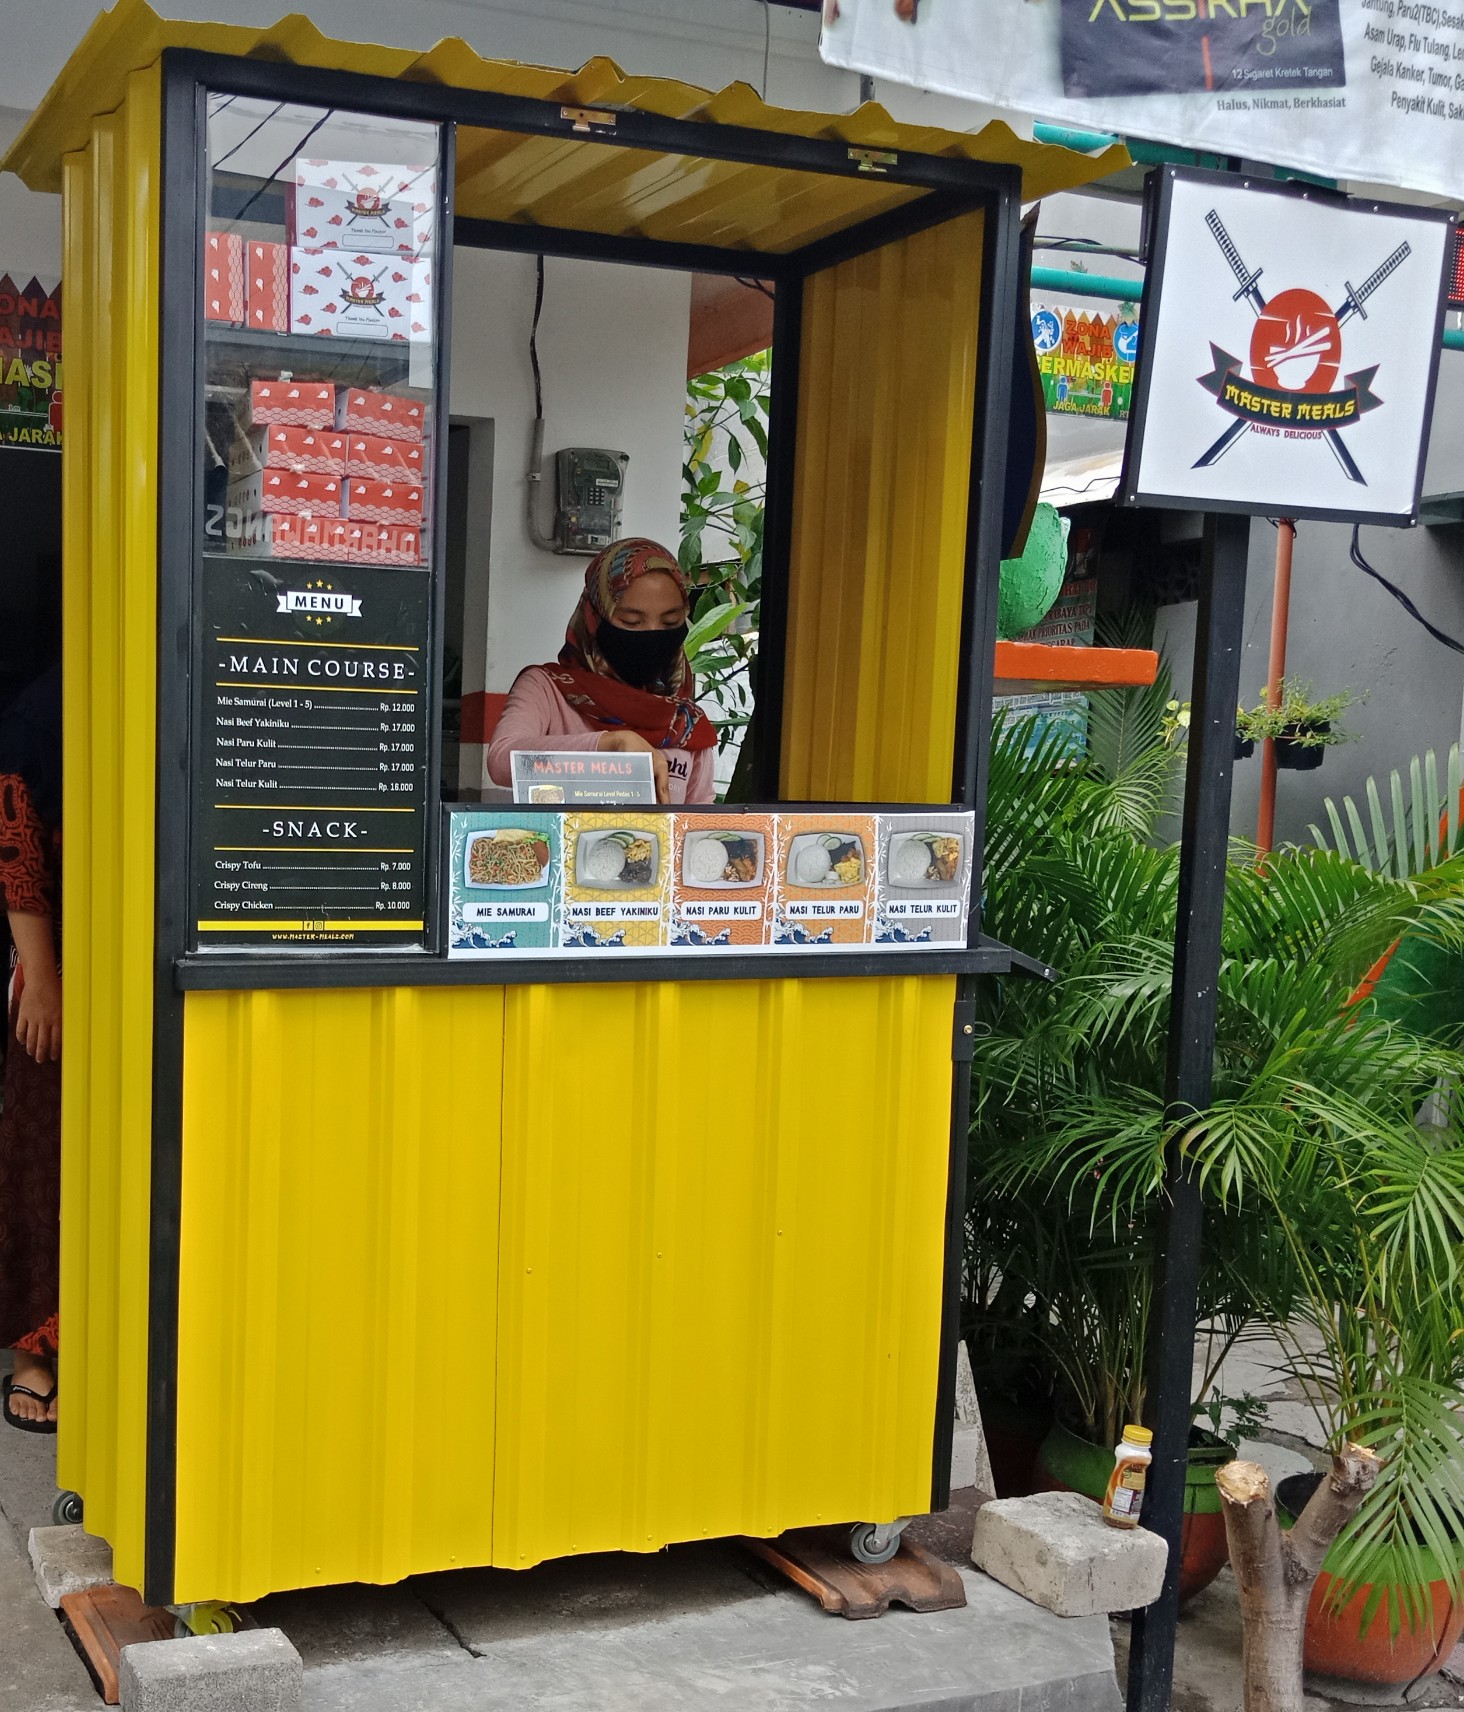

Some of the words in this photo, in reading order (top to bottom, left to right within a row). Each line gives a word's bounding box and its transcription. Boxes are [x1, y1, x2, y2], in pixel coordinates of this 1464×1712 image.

[1256, 6, 1312, 55] gold
[1364, 22, 1385, 43] Asam
[1408, 33, 1421, 52] Flu
[1423, 36, 1451, 61] Tulang,
[1232, 69, 1242, 79] 12
[1244, 69, 1274, 81] Sigaret
[1275, 67, 1301, 78] Kretek
[1303, 66, 1333, 79] Tangan
[1370, 55, 1394, 79] Gejala
[1396, 61, 1425, 86] Kanker,
[1428, 67, 1453, 92] Tumor,
[1217, 99, 1250, 111] Halus,
[1252, 98, 1291, 110] Nikmat,
[1293, 96, 1346, 109] Berkhasiat
[1391, 91, 1425, 115] Penyakit
[1427, 97, 1446, 120] Kulit,
[1066, 320, 1111, 340] ZONA
[1062, 340, 1113, 359] WAJIB
[1037, 355, 1134, 384] ERMASKE
[1053, 401, 1077, 413] JAGA
[1080, 403, 1110, 416] JARAK
[1225, 384, 1292, 419] MASTER
[1296, 400, 1356, 421] MEALS
[1250, 423, 1280, 438] ALWAYS
[1284, 430, 1323, 440] DELICIOUS
[295, 595, 344, 609] MENU
[217, 696, 233, 706] Mie
[234, 697, 267, 706] Samurai
[268, 698, 292, 710] (Level
[380, 703, 391, 713] Rp.
[392, 703, 415, 712] 12.000
[216, 716, 235, 726] Nasi
[236, 717, 254, 727] Beef
[254, 718, 290, 728] Yakiniku
[380, 723, 390, 733] Rp.
[392, 723, 415, 732] 17.000
[216, 737, 235, 747] Nasi
[236, 738, 255, 747] Paru
[256, 738, 276, 748] Kulit
[379, 743, 389, 753] Rp.
[391, 743, 414, 752] 17.000
[215, 758, 234, 767] Nasi
[235, 758, 257, 768] Telur
[258, 759, 276, 768] Paru
[379, 762, 389, 772] Rp.
[391, 763, 414, 772] 17.000
[534, 761, 585, 775] MASTER
[590, 761, 633, 775] MEALS
[215, 778, 234, 787] Nasi
[235, 779, 257, 788] Telur
[258, 779, 278, 789] Kulit
[378, 782, 389, 793] Rp.
[214, 860, 241, 872] Crispy
[242, 860, 262, 870] Tofu
[380, 862, 391, 872] Rp.
[392, 862, 411, 871] 7.000
[214, 880, 241, 892] Crispy
[241, 880, 269, 892] Cireng
[380, 881, 391, 892] Rp.
[392, 882, 411, 890] 8.000
[214, 900, 241, 912] Crispy
[241, 900, 274, 910] Chicken
[375, 901, 386, 911] Rp.
[387, 901, 410, 910] 10.000
[476, 907, 492, 917] MIE
[497, 907, 536, 917] SAMURAI
[572, 907, 591, 917] NASI
[595, 907, 616, 917] BEEF
[619, 906, 659, 916] YAKINIKU
[686, 906, 705, 915] NASI
[708, 906, 729, 915] PARU
[733, 906, 757, 915] KULIT
[789, 905, 808, 915] NASI
[812, 905, 835, 914] TELUR
[839, 905, 860, 914] PARU
[889, 905, 907, 914] NASI
[911, 904, 933, 913] TELUR
[936, 904, 957, 913] KULIT
